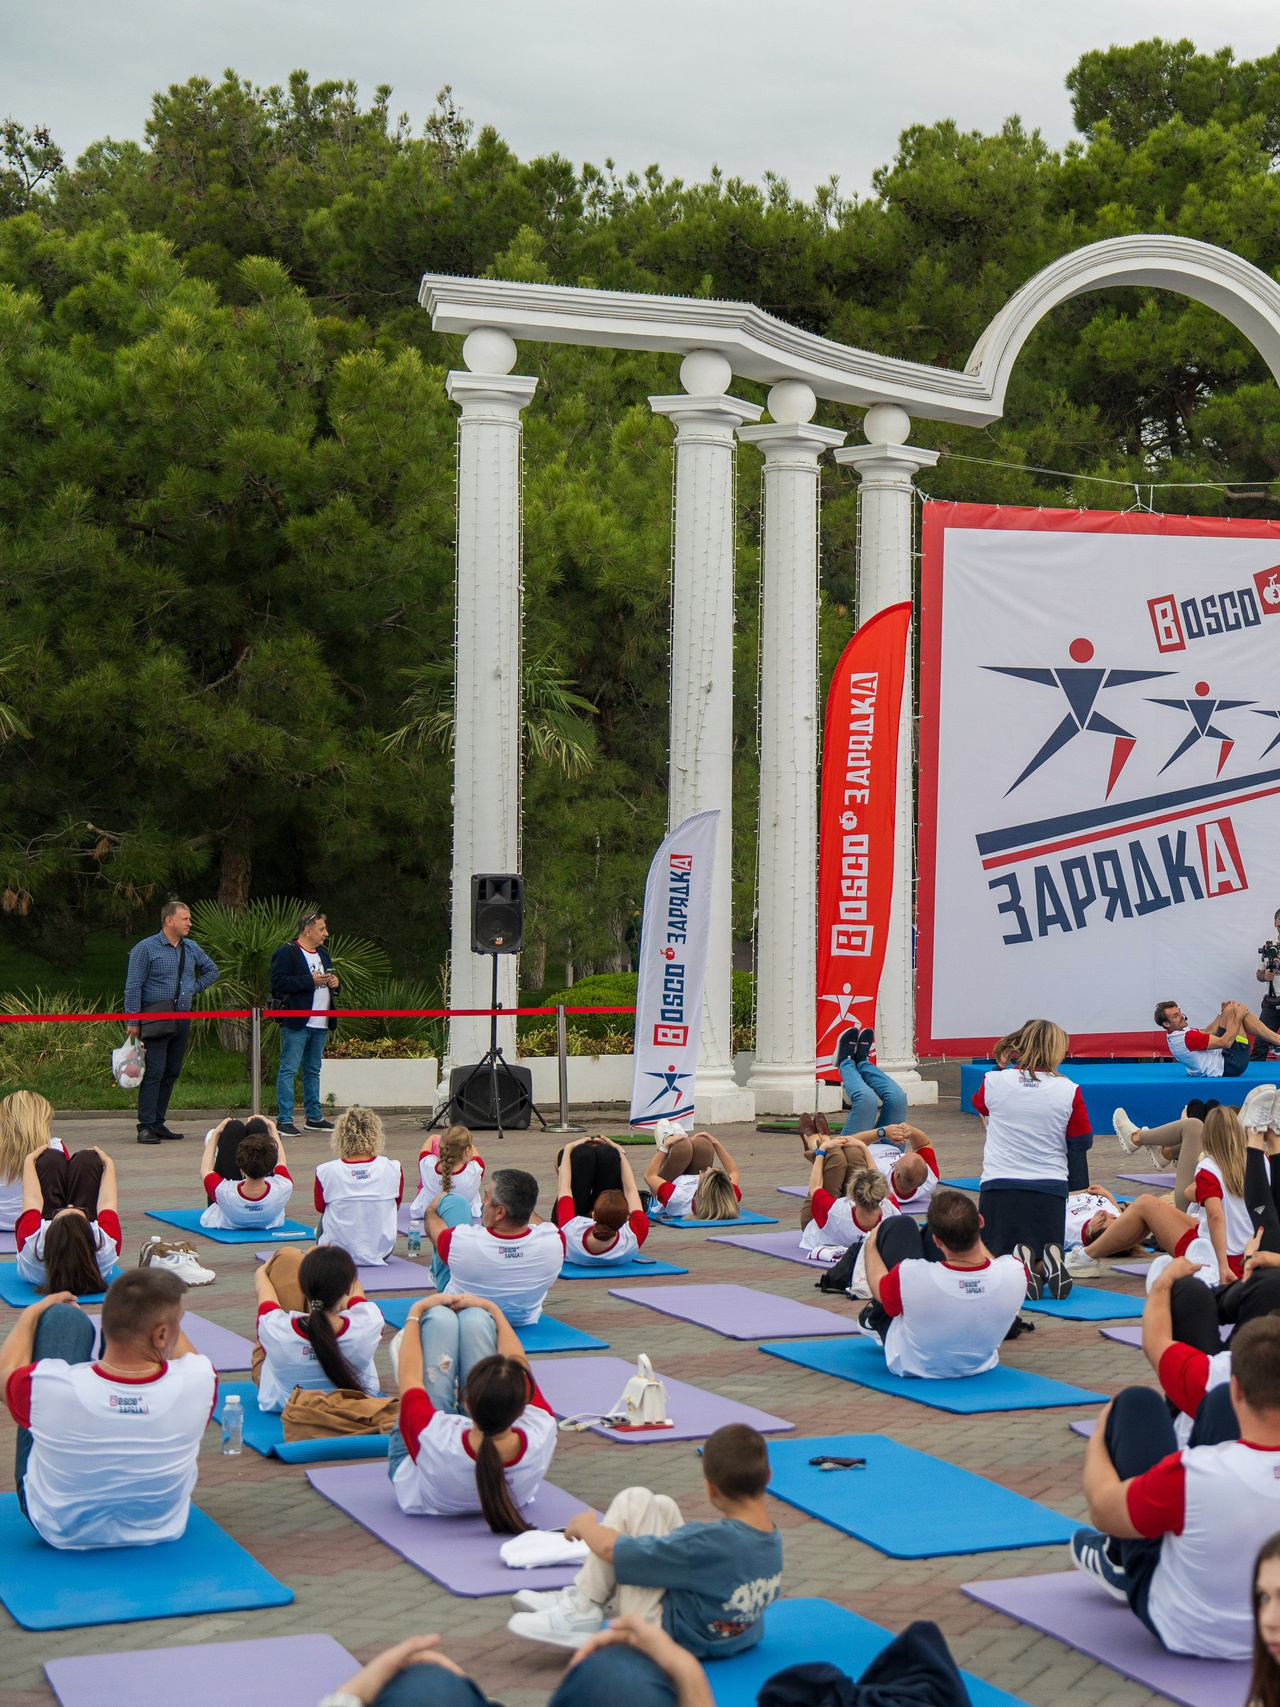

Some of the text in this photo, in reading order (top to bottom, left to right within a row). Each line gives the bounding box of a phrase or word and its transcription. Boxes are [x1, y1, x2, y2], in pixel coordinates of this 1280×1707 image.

[1148, 588, 1260, 652] BOSCO
[831, 672, 878, 956] BOSCO ЗАРЯДКА
[987, 817, 1248, 945] ЗАРЯДКА
[653, 854, 692, 1046] BOSCO ЗАРЯДКА
